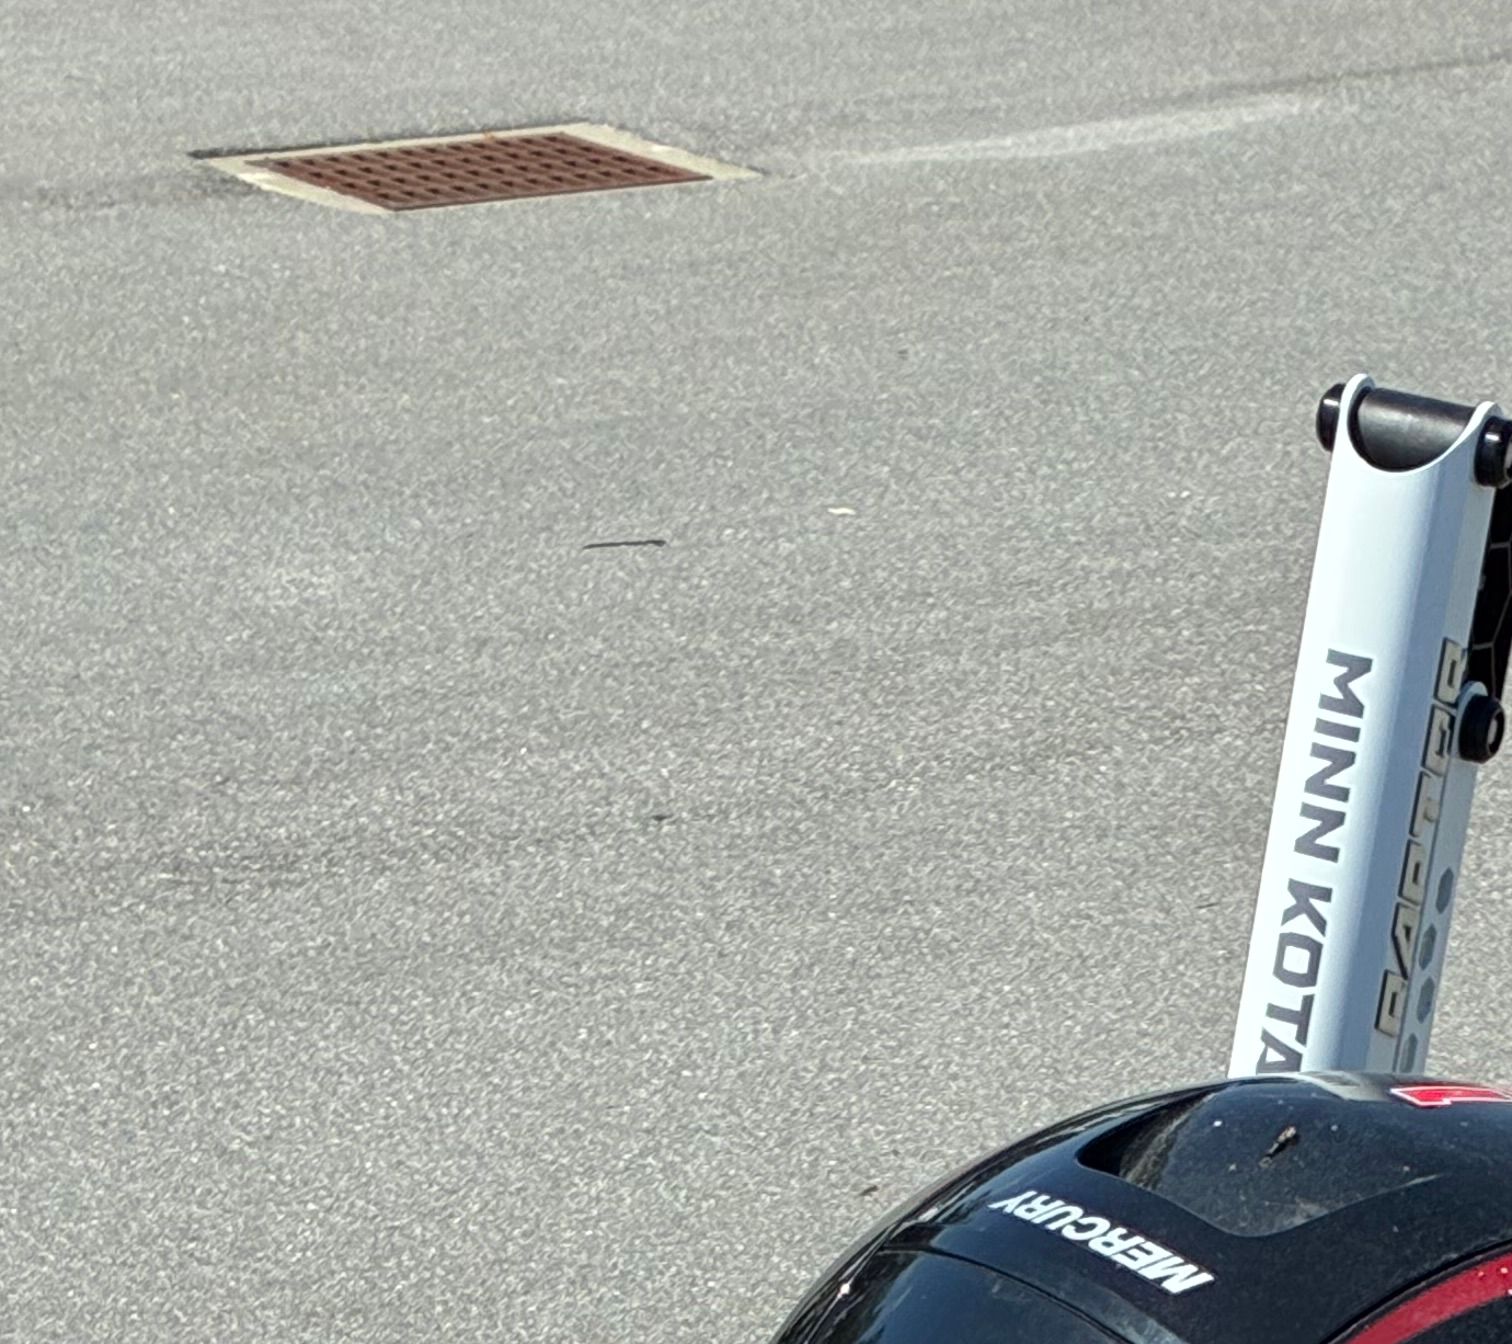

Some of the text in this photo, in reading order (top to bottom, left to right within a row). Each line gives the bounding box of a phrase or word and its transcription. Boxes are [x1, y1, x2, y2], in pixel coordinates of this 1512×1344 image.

[1255, 648, 1374, 1076] MINN KOTA
[991, 1189, 1214, 1294] MERCURY
